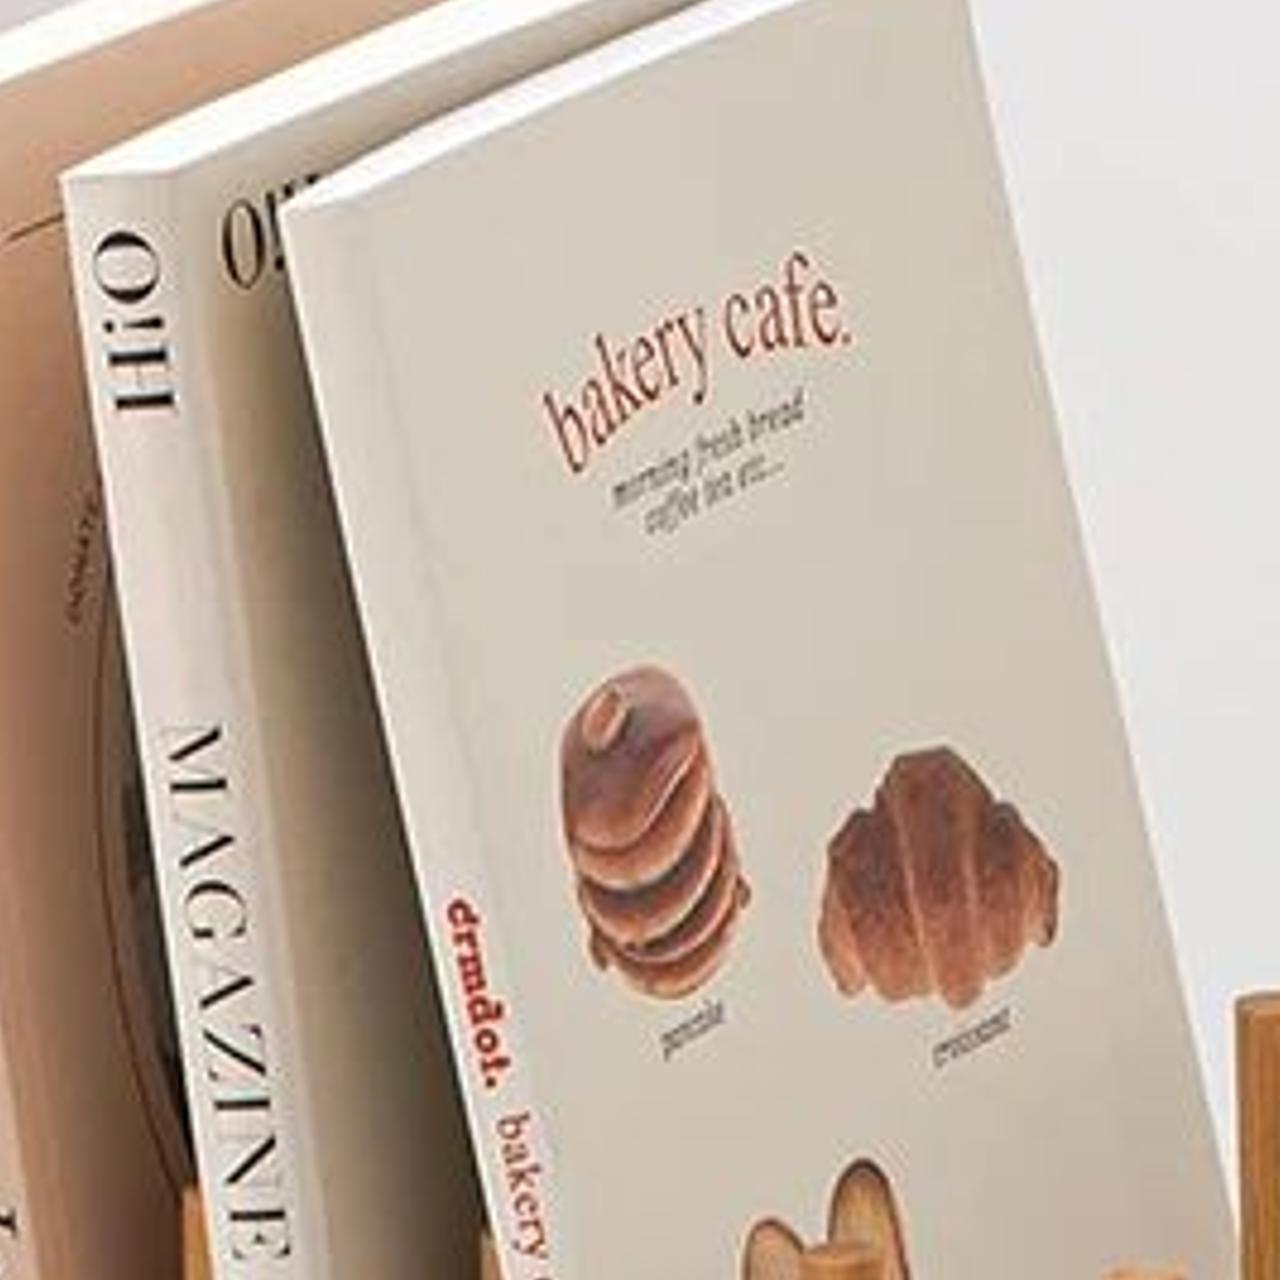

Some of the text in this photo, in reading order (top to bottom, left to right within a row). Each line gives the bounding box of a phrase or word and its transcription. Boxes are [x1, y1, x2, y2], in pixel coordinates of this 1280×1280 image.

[543, 250, 852, 474] bakery cafe.
[160, 724, 291, 1261] MAGAZINE
[496, 1110, 550, 1261] bakery
